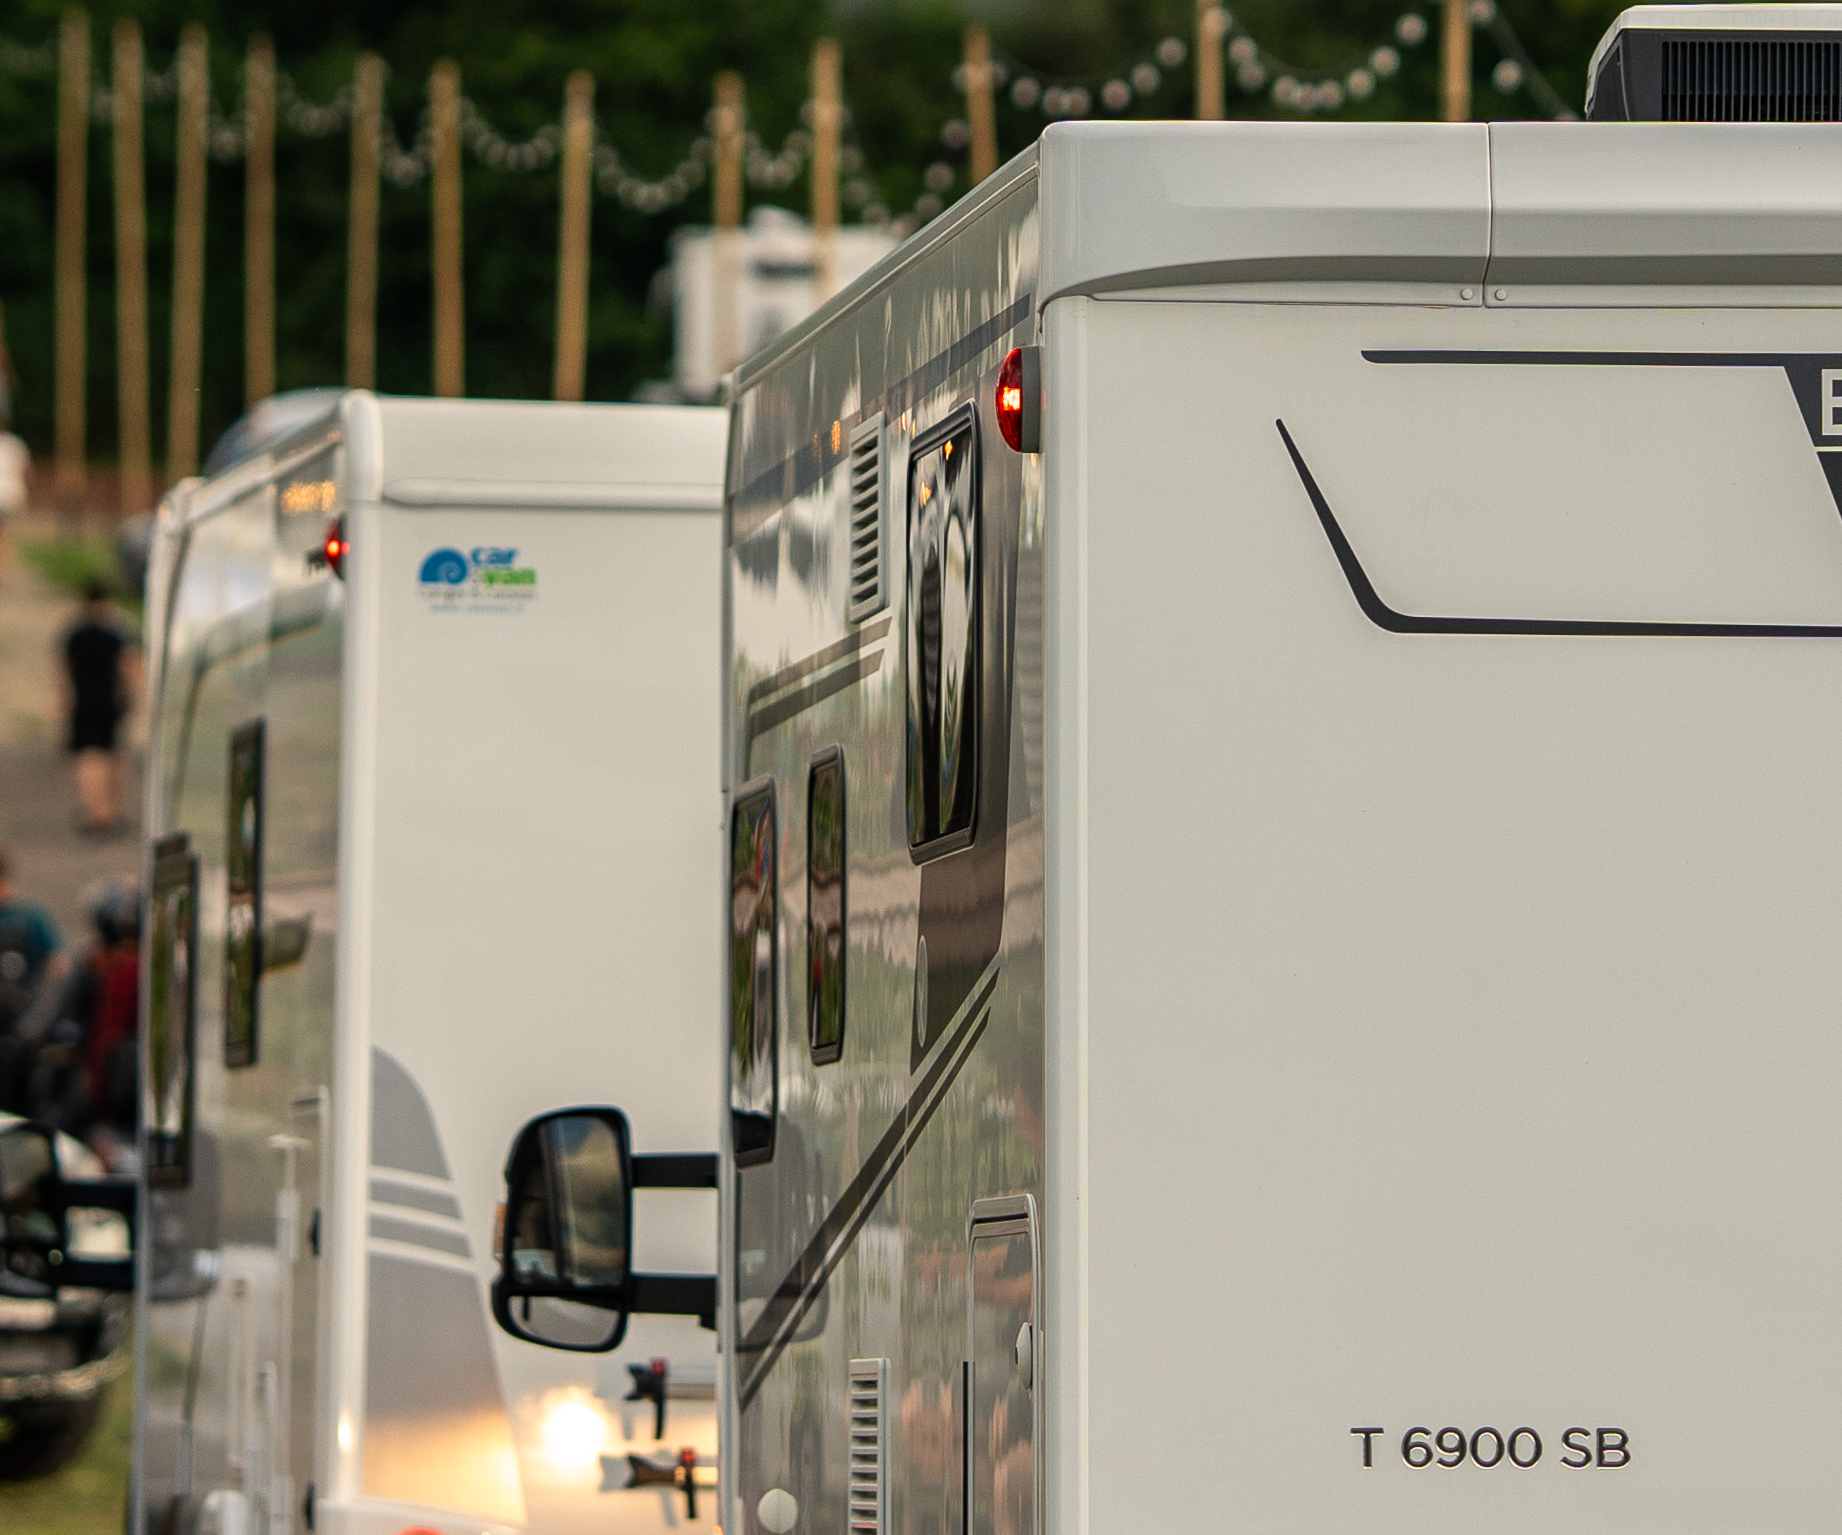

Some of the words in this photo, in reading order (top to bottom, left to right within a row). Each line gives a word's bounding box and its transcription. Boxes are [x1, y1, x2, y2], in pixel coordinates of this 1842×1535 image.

[1350, 1427, 1385, 1468] T
[1401, 1427, 1543, 1469] 6900
[1560, 1427, 1632, 1469] SB
